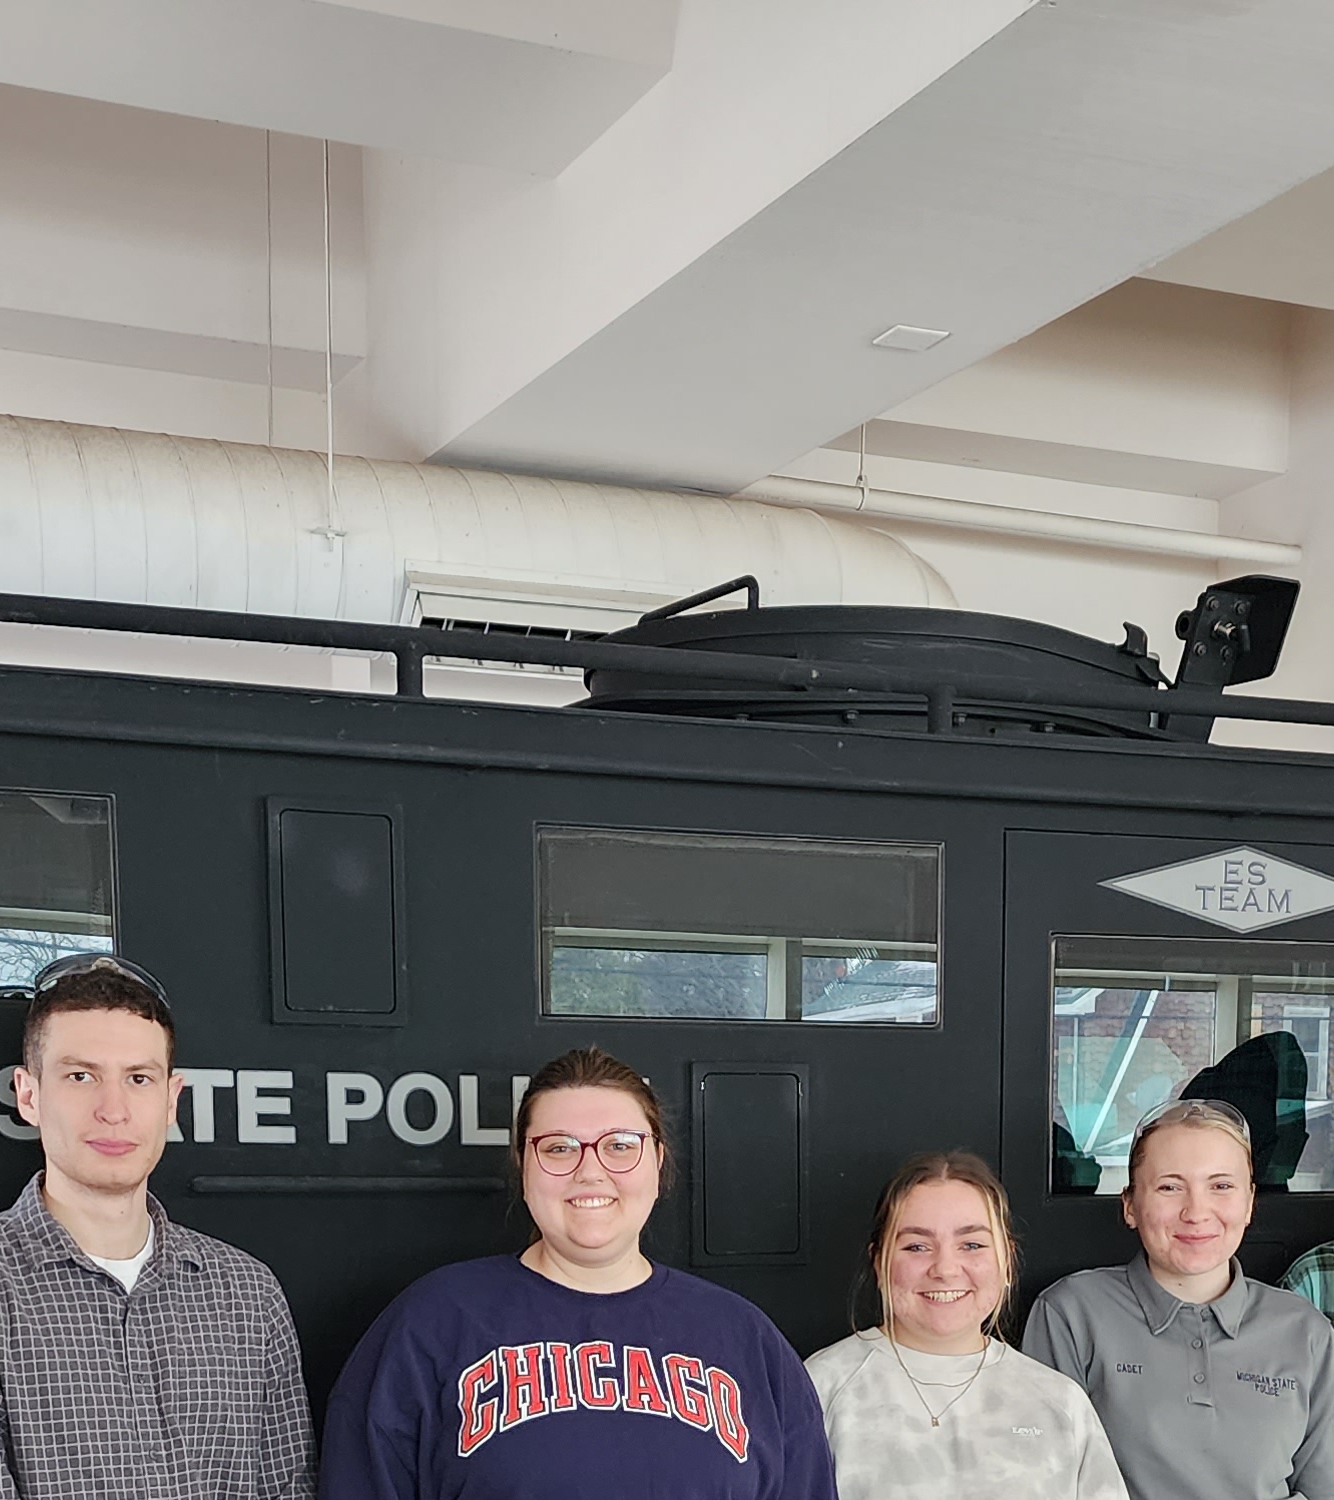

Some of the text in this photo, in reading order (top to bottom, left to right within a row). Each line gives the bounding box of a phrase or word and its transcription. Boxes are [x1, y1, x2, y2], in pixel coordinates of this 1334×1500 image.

[1223, 859, 1268, 886] ES
[1194, 884, 1292, 914] TEAM
[1116, 1363, 1143, 1375] CADET
[1271, 1377, 1296, 1390] STATE
[457, 1340, 750, 1464] CHICAGO
